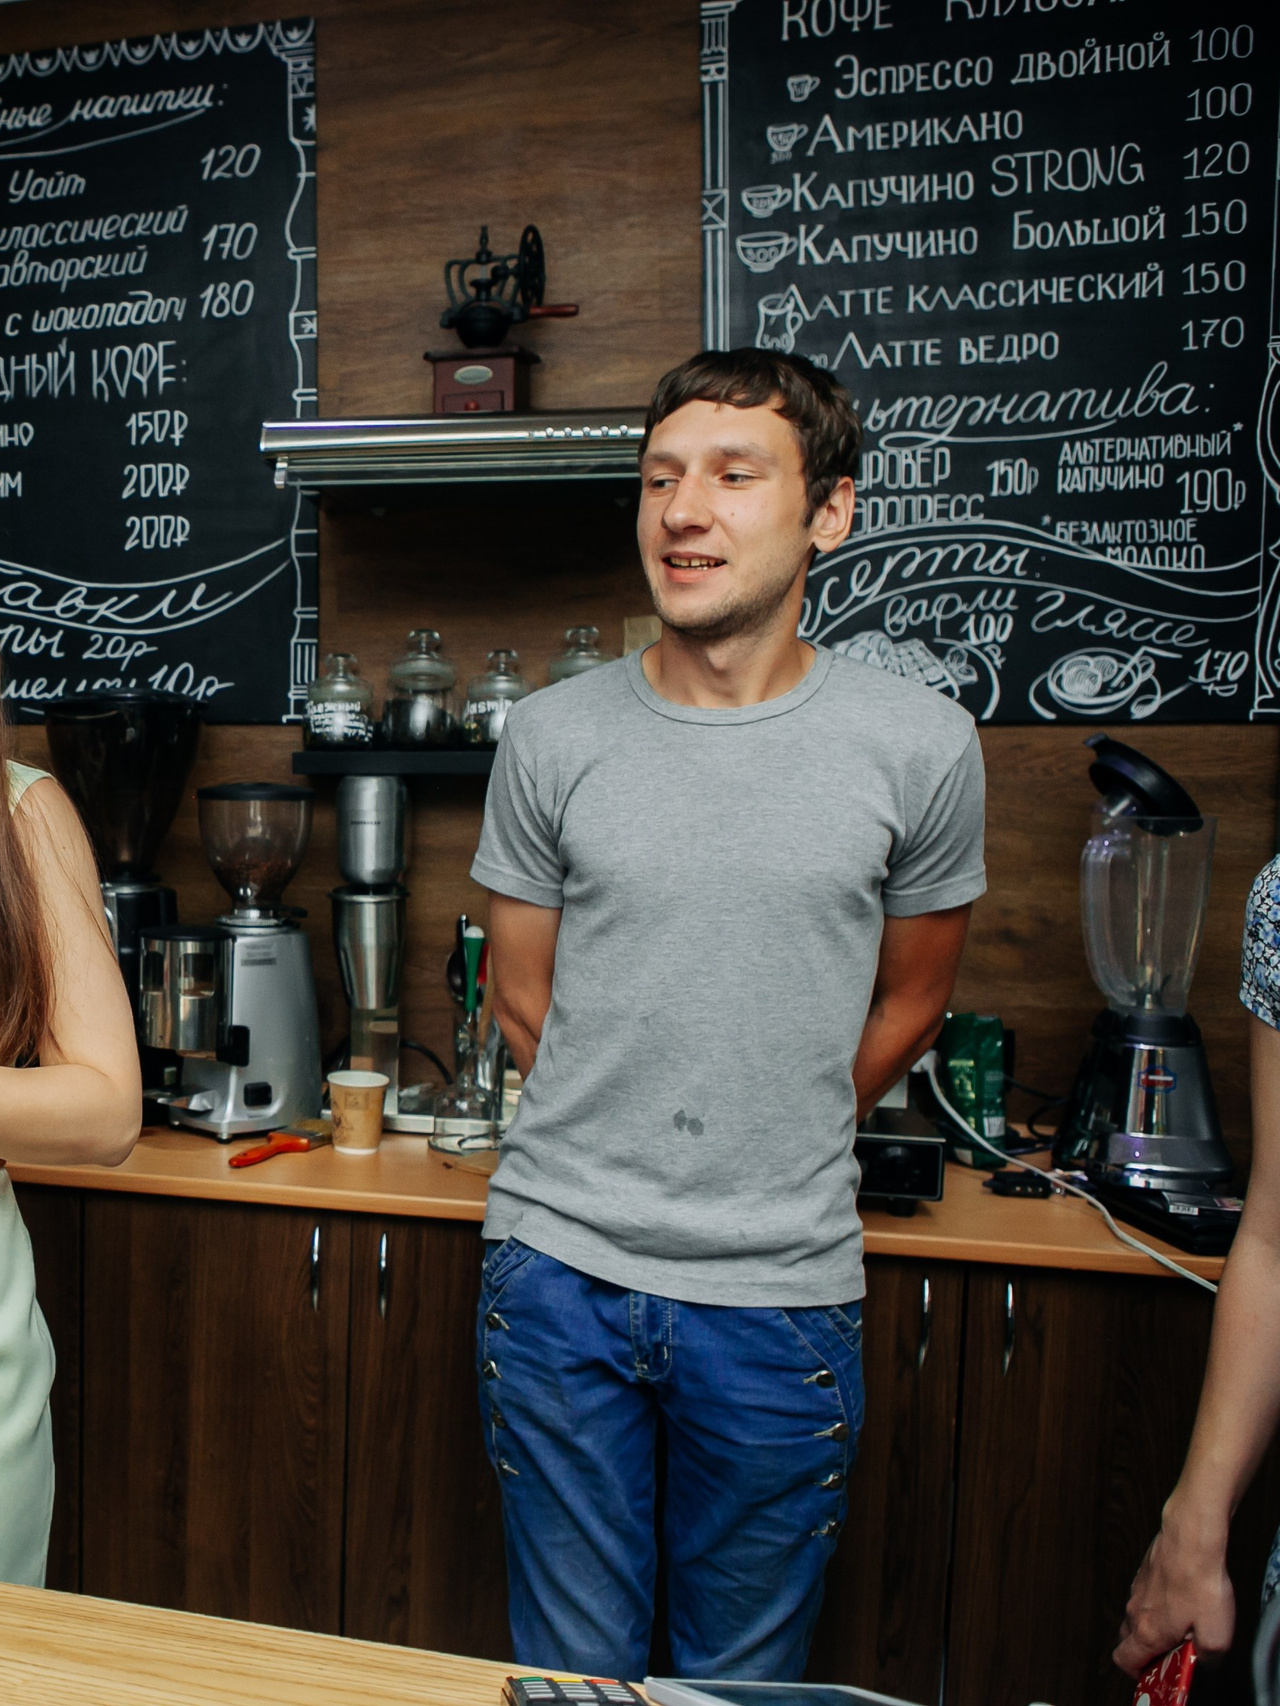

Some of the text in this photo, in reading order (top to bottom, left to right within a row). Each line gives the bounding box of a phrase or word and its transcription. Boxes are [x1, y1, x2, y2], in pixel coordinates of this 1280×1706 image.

[781, 0, 893, 41] КОФЕ
[1188, 24, 1255, 63] 100
[1184, 83, 1253, 121] 100
[8, 169, 86, 204] Уайт
[200, 144, 262, 180] 120
[991, 142, 1146, 197] STRONG
[1181, 141, 1251, 181] 120
[1180, 199, 1248, 239] 150
[202, 222, 259, 261] 170
[1181, 260, 1247, 296] 150
[32, 290, 187, 333] шоколадом
[199, 279, 255, 318] 180
[1180, 316, 1245, 352] 170
[92, 341, 187, 402] КОФЕ:
[1057, 463, 1165, 494] КАПУЧИНО
[1055, 518, 1198, 546] БЕЗЛАКТОЗНОЕ
[1106, 544, 1206, 570] МОЛОКО
[883, 588, 1019, 637] вафли
[959, 612, 1014, 646] 100
[1031, 590, 1211, 648] Гляссе
[1189, 648, 1250, 683] 170
